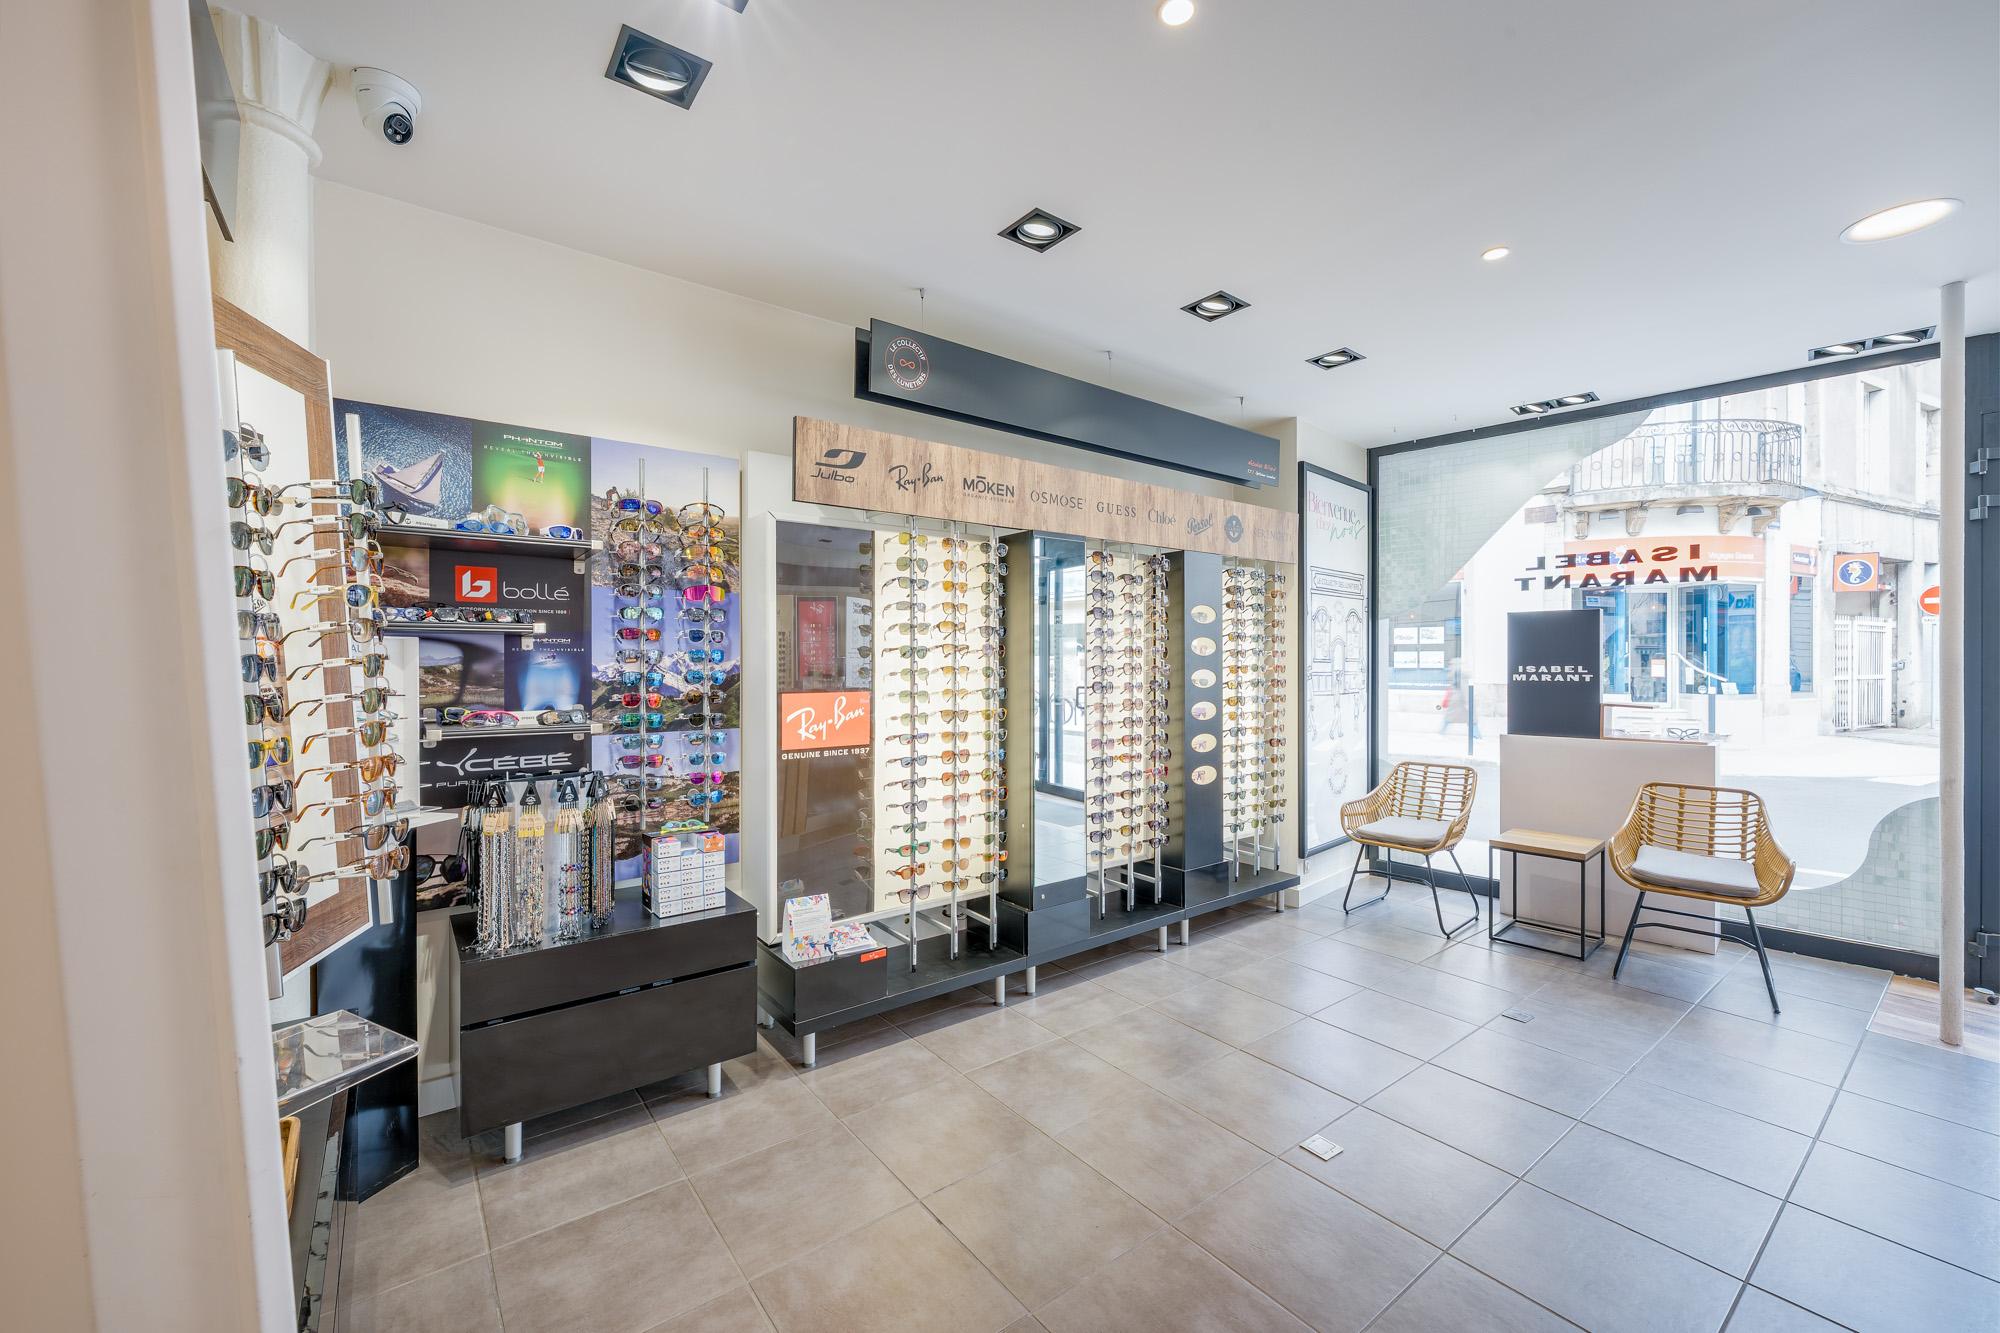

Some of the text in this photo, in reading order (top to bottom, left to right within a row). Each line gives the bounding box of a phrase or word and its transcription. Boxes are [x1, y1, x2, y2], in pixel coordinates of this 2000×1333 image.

[889, 339, 925, 361] LE COLLECTIF
[887, 364, 927, 389] DES LUNETIERS
[541, 453, 582, 462] NVISIBLE
[810, 468, 855, 483] Julbo
[1096, 501, 1136, 518] GUESS
[1308, 490, 1356, 524] Bienvenue
[1186, 513, 1213, 536] Persol
[502, 581, 570, 601] bollé
[1512, 673, 1594, 682] MARANT
[1518, 665, 1588, 673] ISABEL
[786, 696, 864, 741] Ray-Ban
[781, 751, 821, 760] GENUINE
[824, 749, 849, 757] SINCE
